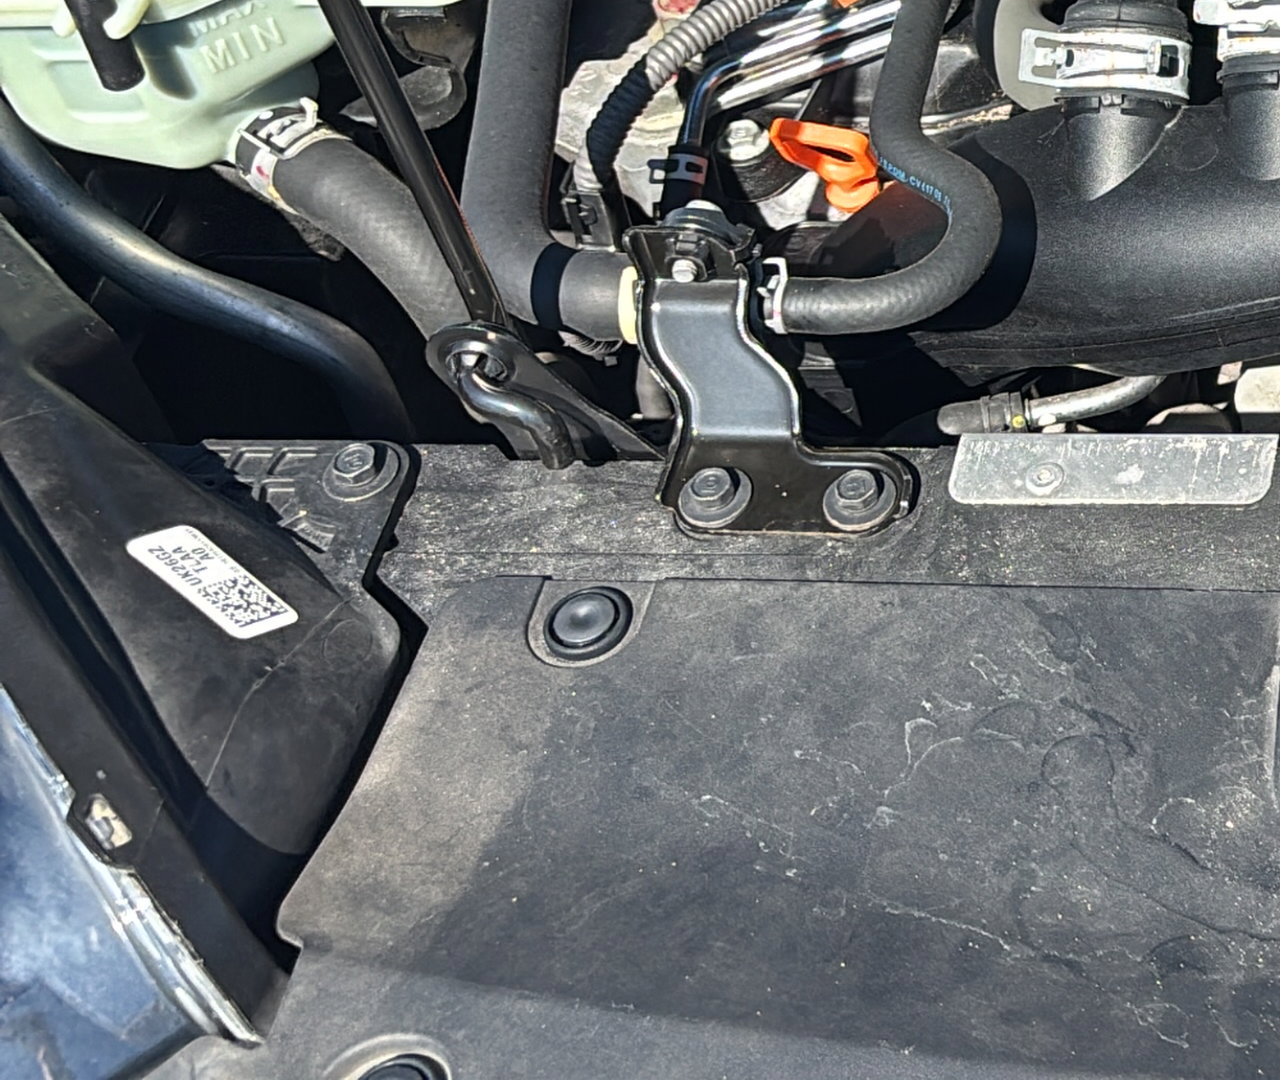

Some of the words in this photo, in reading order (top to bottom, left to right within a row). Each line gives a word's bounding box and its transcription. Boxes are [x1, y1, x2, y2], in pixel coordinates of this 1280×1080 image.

[200, 16, 285, 73] MIN
[148, 545, 203, 587] UK26GZ
[171, 545, 209, 575] TLAA
